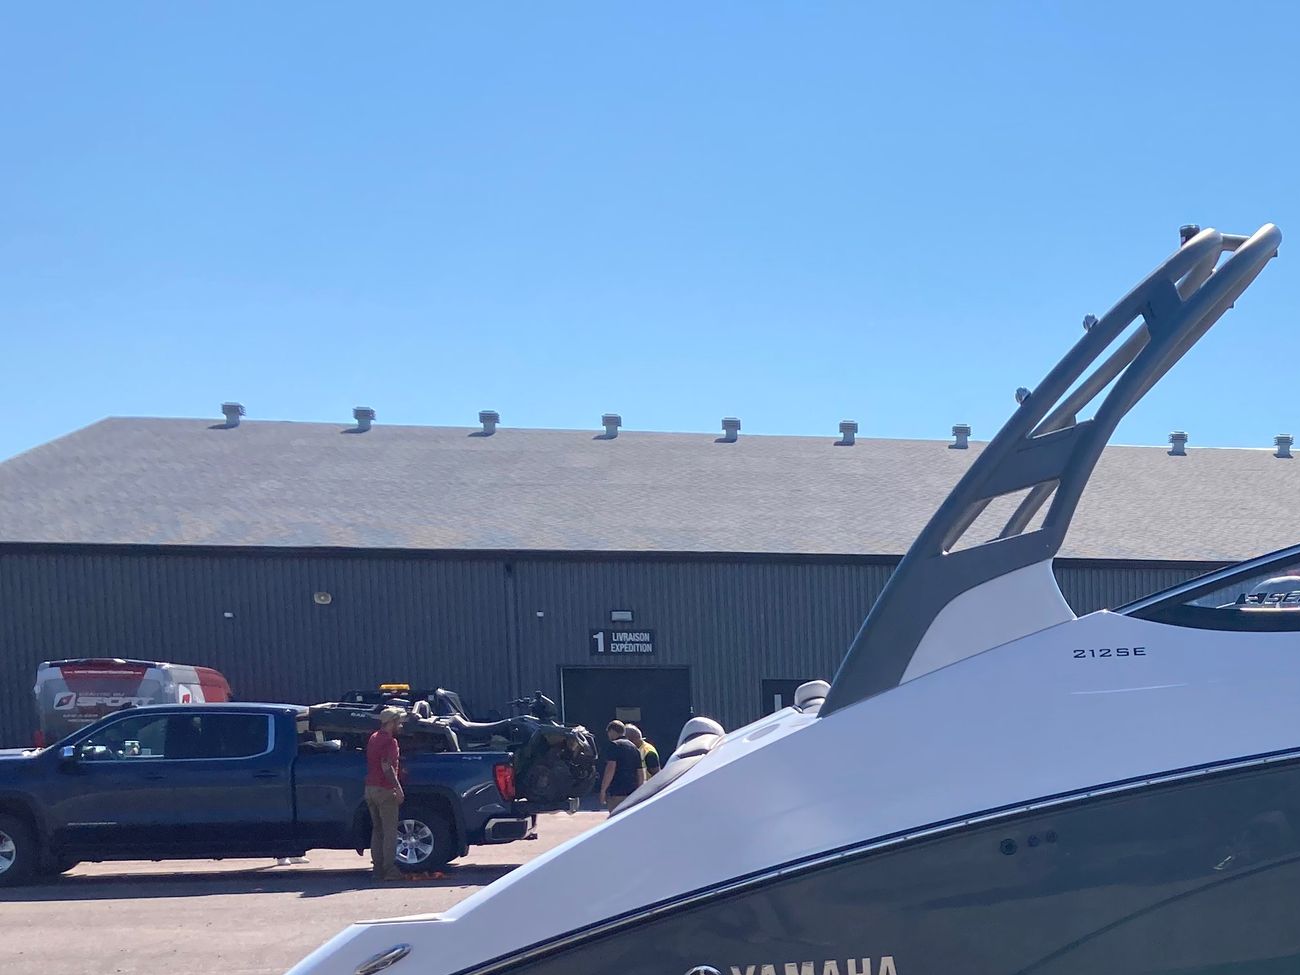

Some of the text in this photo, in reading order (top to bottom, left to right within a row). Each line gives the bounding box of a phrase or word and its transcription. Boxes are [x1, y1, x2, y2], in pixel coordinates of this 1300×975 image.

[592, 631, 605, 653] 1
[611, 632, 650, 642] LIVRAISON
[610, 641, 653, 653] EXPÉDITION
